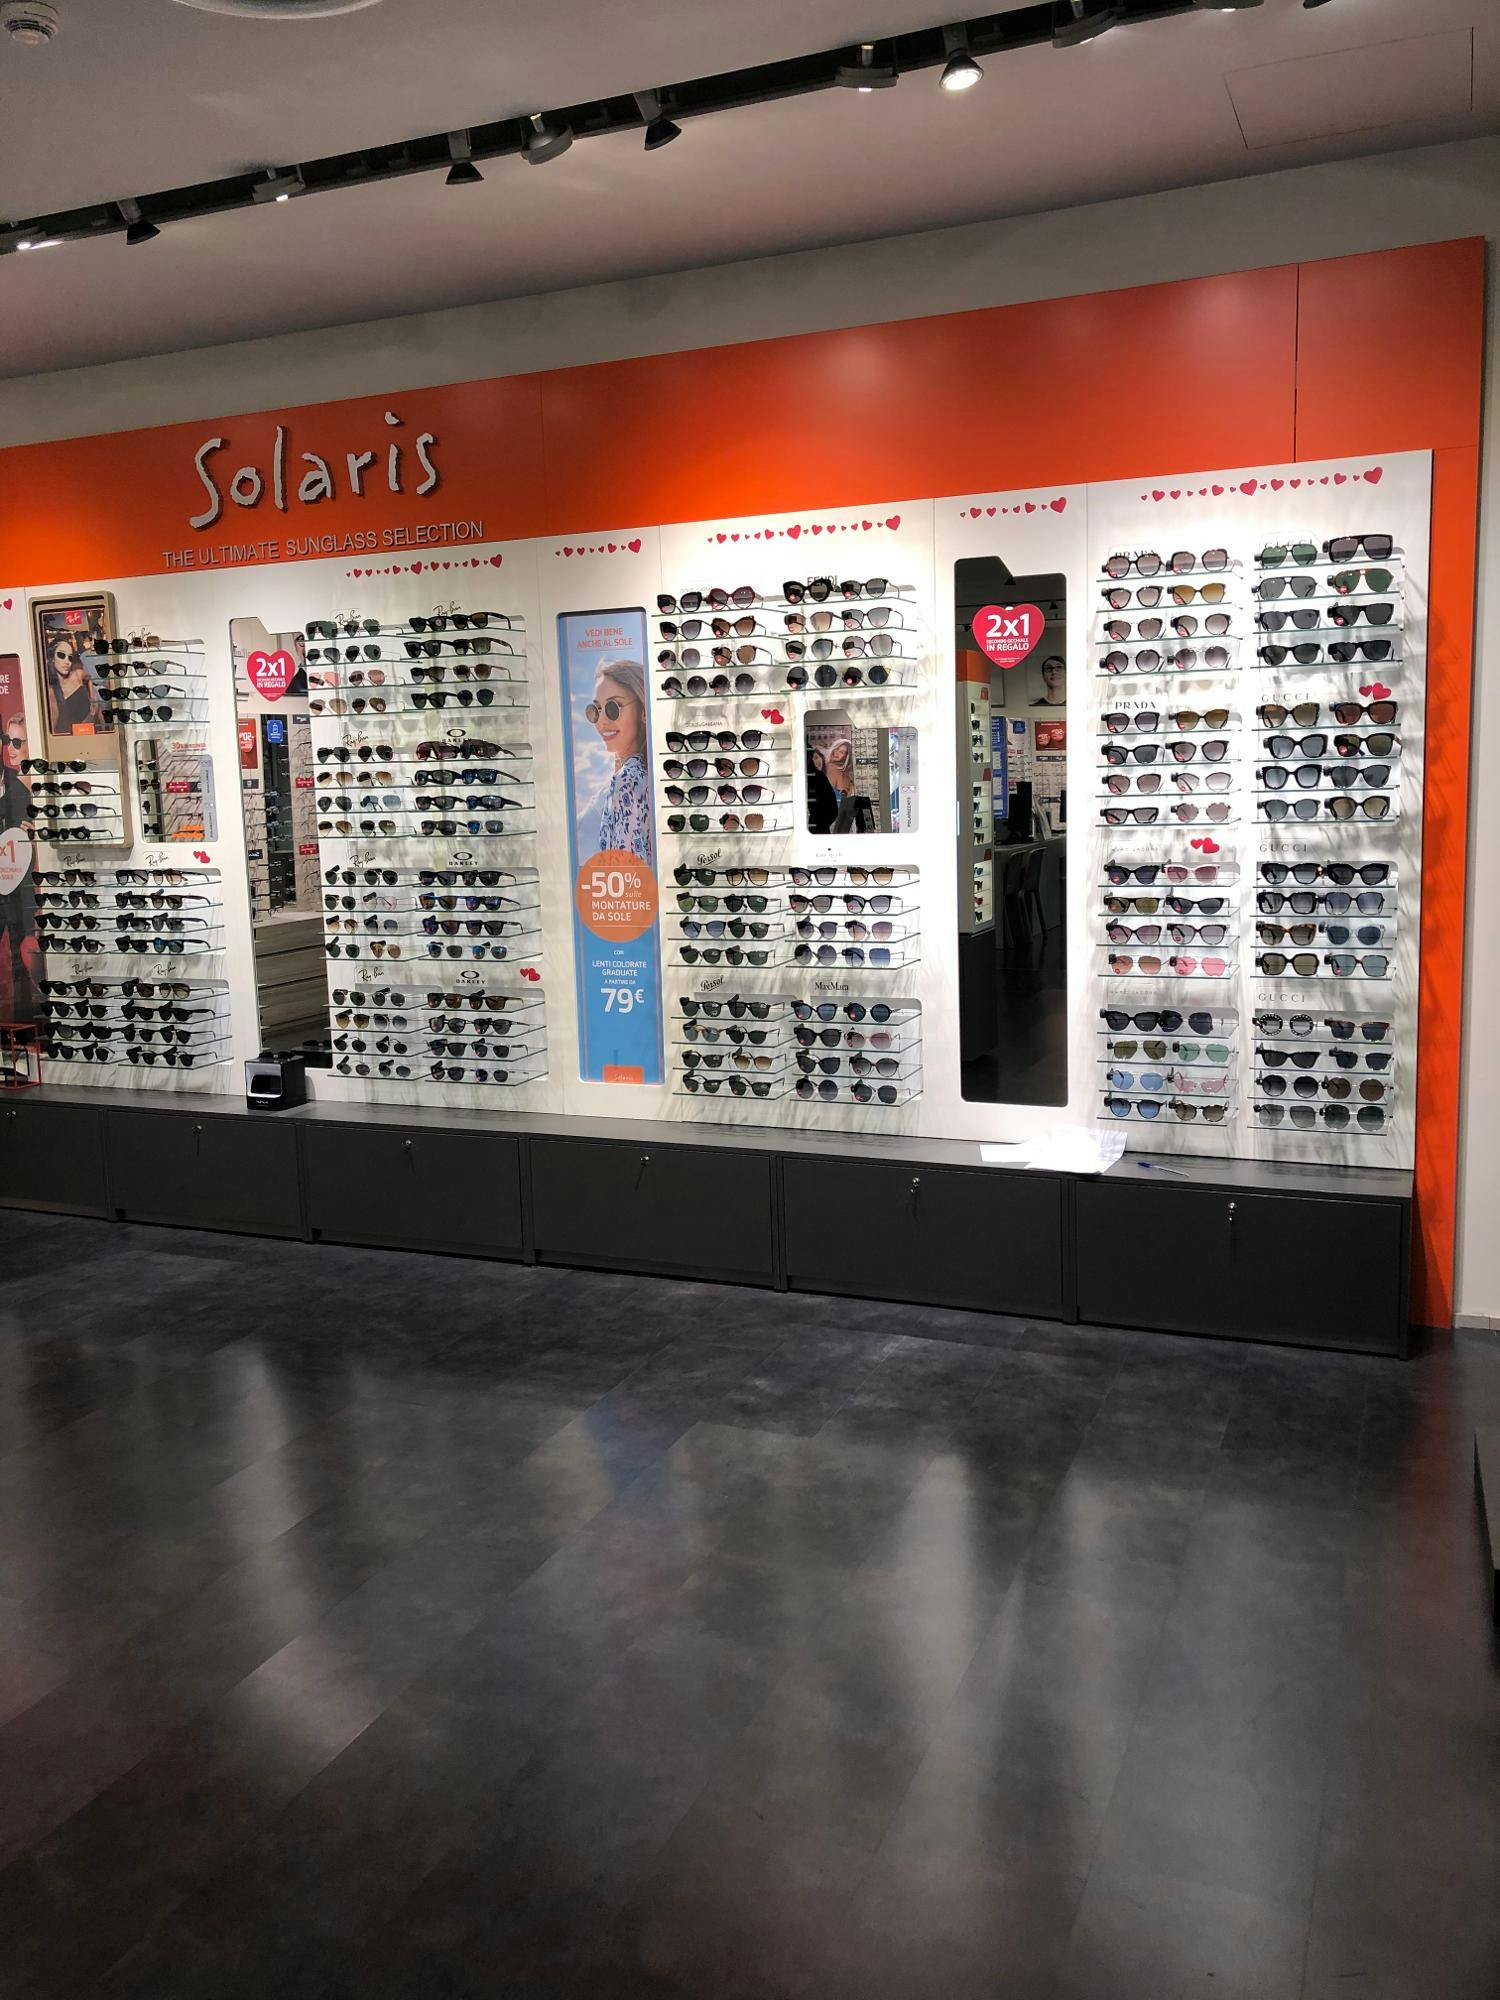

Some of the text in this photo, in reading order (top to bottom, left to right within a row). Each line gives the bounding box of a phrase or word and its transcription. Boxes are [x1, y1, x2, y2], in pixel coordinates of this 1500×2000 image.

[189, 411, 437, 529] Solaris
[163, 520, 484, 568] THE ULTIMATE SUNGLASS SELECTION
[986, 613, 1029, 637] 2x1
[585, 627, 624, 637] VEDI BENE
[577, 640, 601, 648] ANCHE
[614, 638, 633, 647] SOLE
[997, 643, 1029, 651] REGALO
[256, 657, 286, 677] 2x1
[1262, 693, 1309, 702] GUCCI
[1115, 702, 1156, 710] PRADA
[1260, 844, 1307, 852] GUCCI
[697, 848, 722, 866] Persol
[581, 871, 642, 898] -50%
[592, 901, 652, 910] MONTATURE
[592, 912, 632, 921] DA SOLE
[592, 960, 611, 968] LENTI
[700, 976, 725, 992] Persol
[815, 981, 849, 991] MaxMara
[600, 988, 645, 1013] 79€
